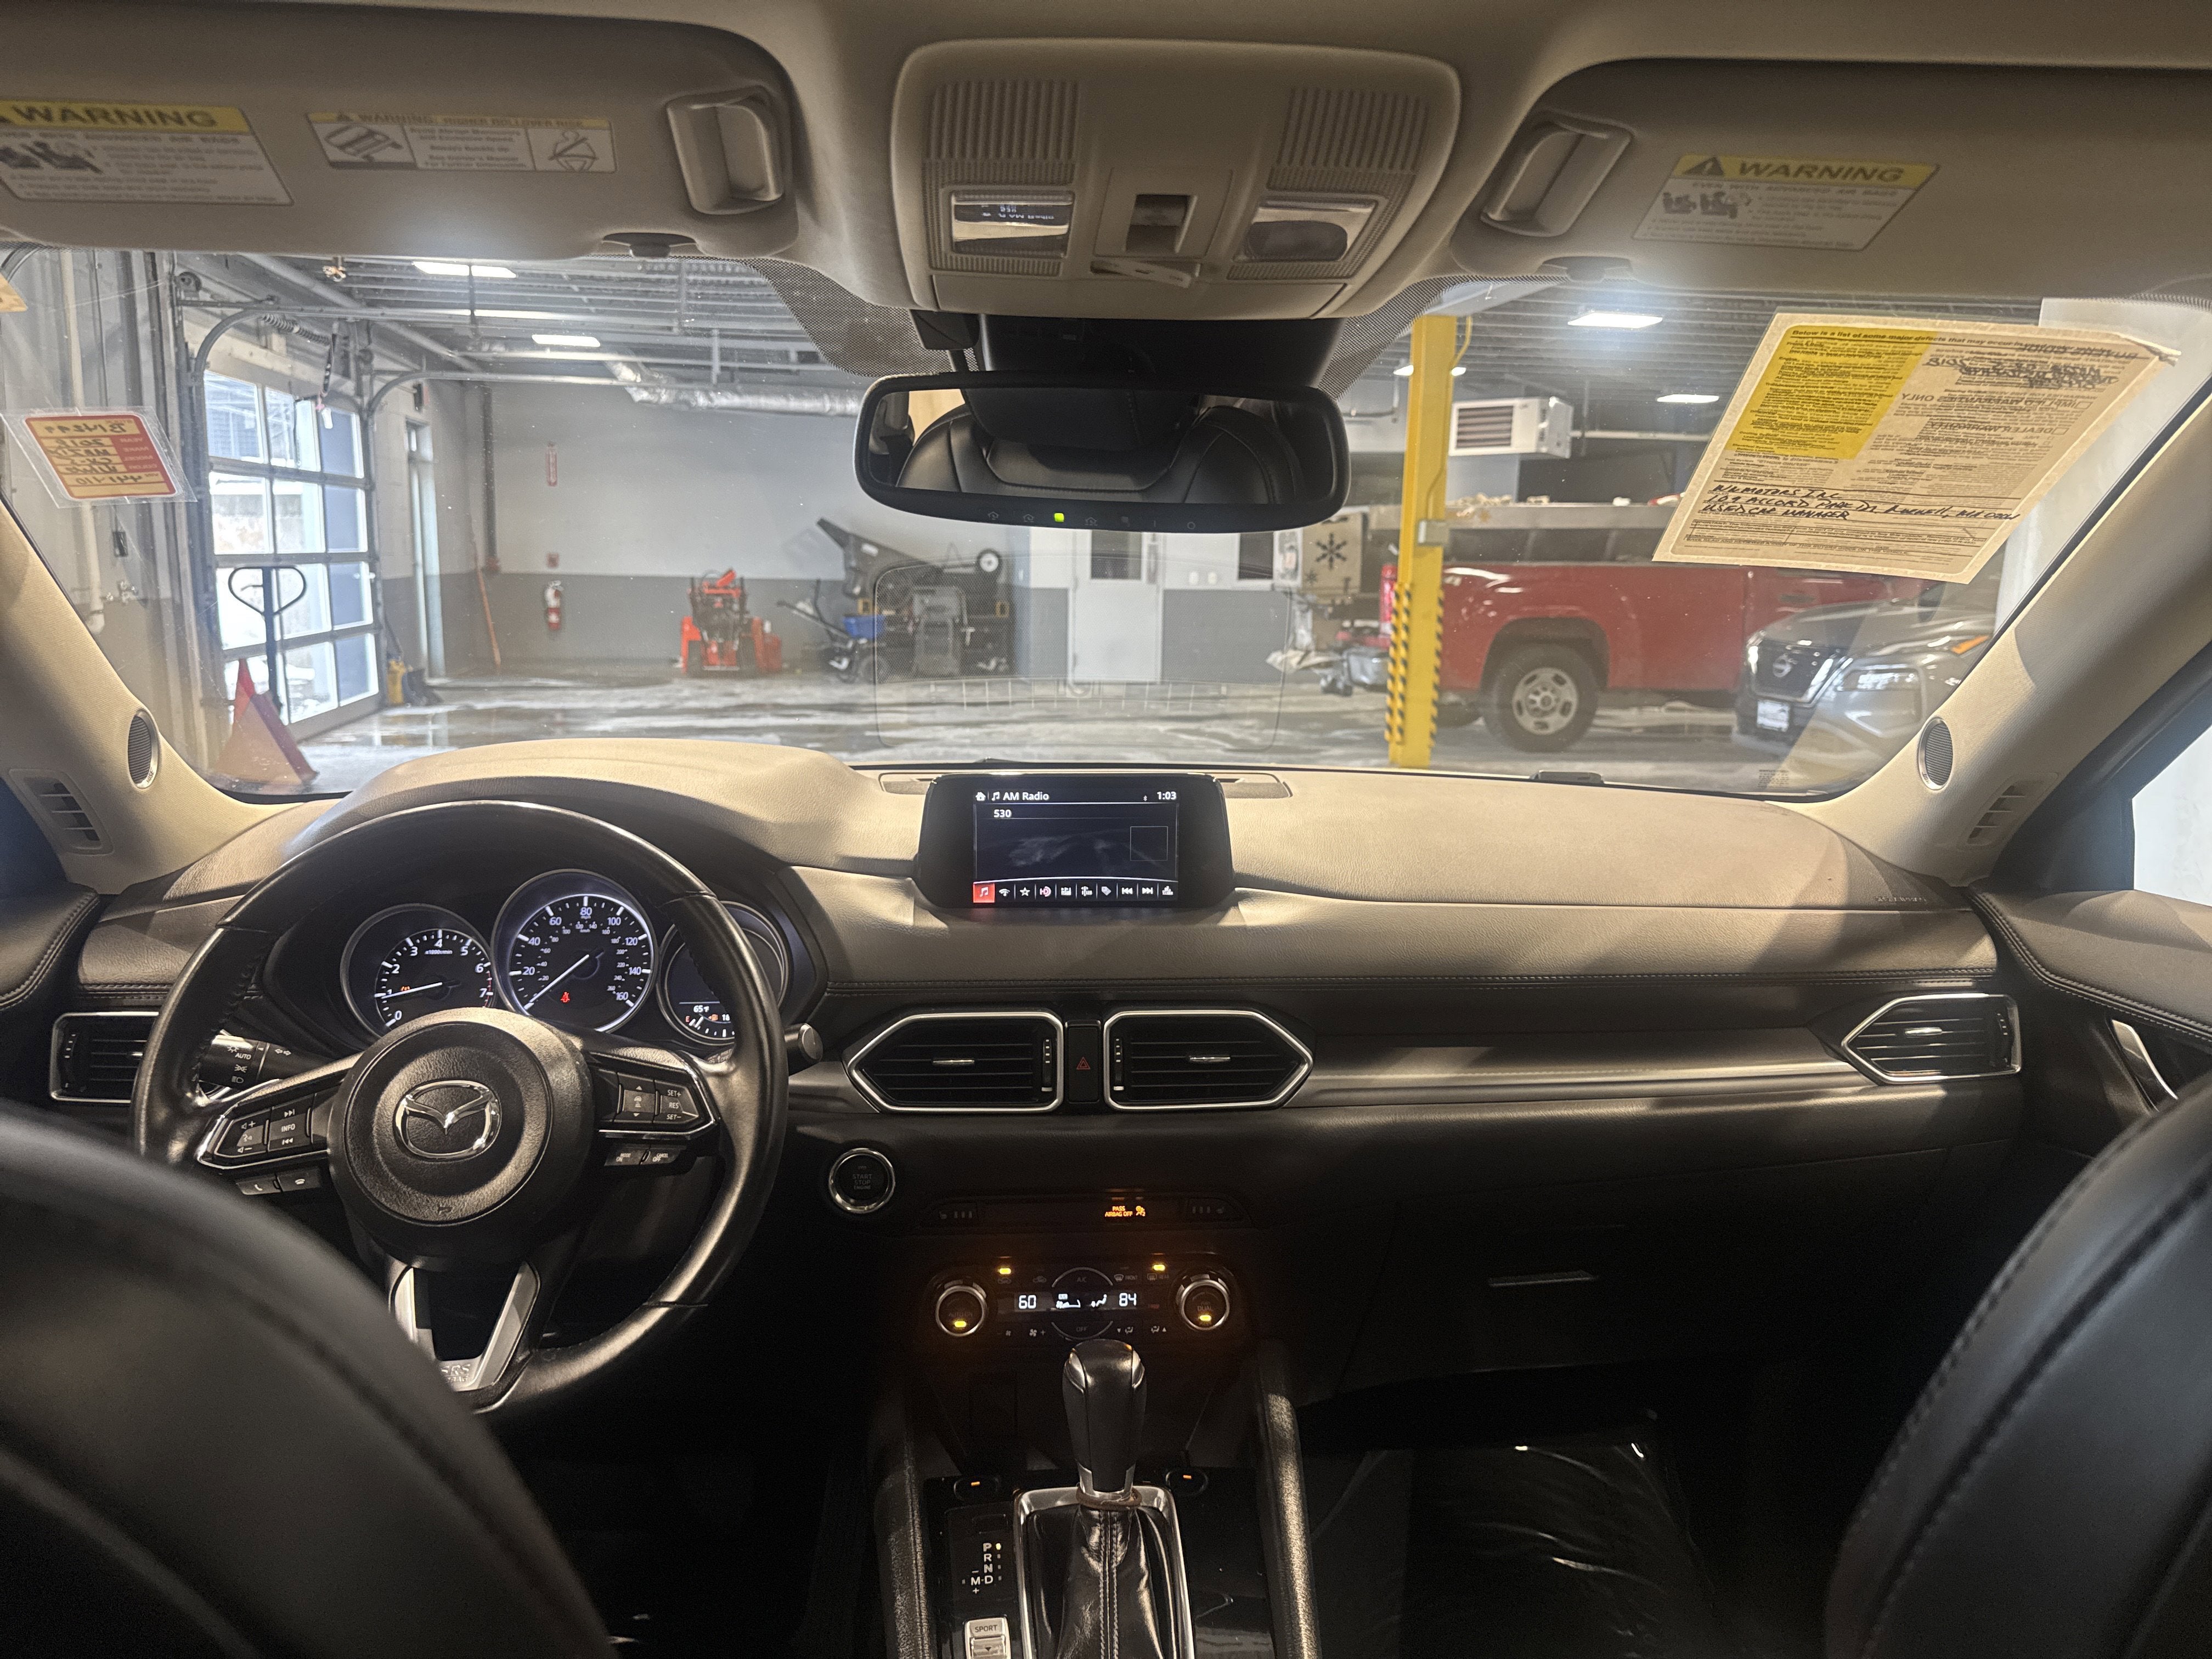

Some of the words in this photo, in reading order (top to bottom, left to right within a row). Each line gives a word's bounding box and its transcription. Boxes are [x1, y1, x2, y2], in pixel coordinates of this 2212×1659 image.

[11, 105, 218, 127] WARNING
[1739, 160, 1905, 182] WARNING
[1746, 497, 1809, 507] ACCORD
[1002, 792, 1019, 801] AM
[1023, 792, 1049, 801] Radio
[1156, 792, 1177, 800] 1:03
[994, 809, 1012, 818] 530
[580, 907, 592, 916] 80
[549, 917, 562, 926] 60
[607, 917, 622, 926] 100
[433, 939, 443, 948] 4
[528, 937, 541, 946] 40
[625, 937, 638, 946] 120
[409, 946, 418, 956] 3
[460, 945, 469, 956] 5
[392, 963, 400, 974] 2
[475, 963, 483, 973] 6
[522, 966, 535, 975] 20
[628, 967, 642, 975] 140
[479, 988, 487, 998] 7
[616, 992, 629, 1001] 160
[394, 1010, 402, 1020] 0
[667, 1089, 681, 1097] SET+
[281, 1123, 296, 1132] INFO
[1018, 1295, 1037, 1310] 60
[1119, 1293, 1137, 1307] 84
[983, 1543, 992, 1553] P
[984, 1553, 992, 1561] R
[984, 1564, 993, 1573] N
[970, 1577, 981, 1585] M
[985, 1575, 994, 1584] D
[974, 1624, 998, 1633] SPORT
